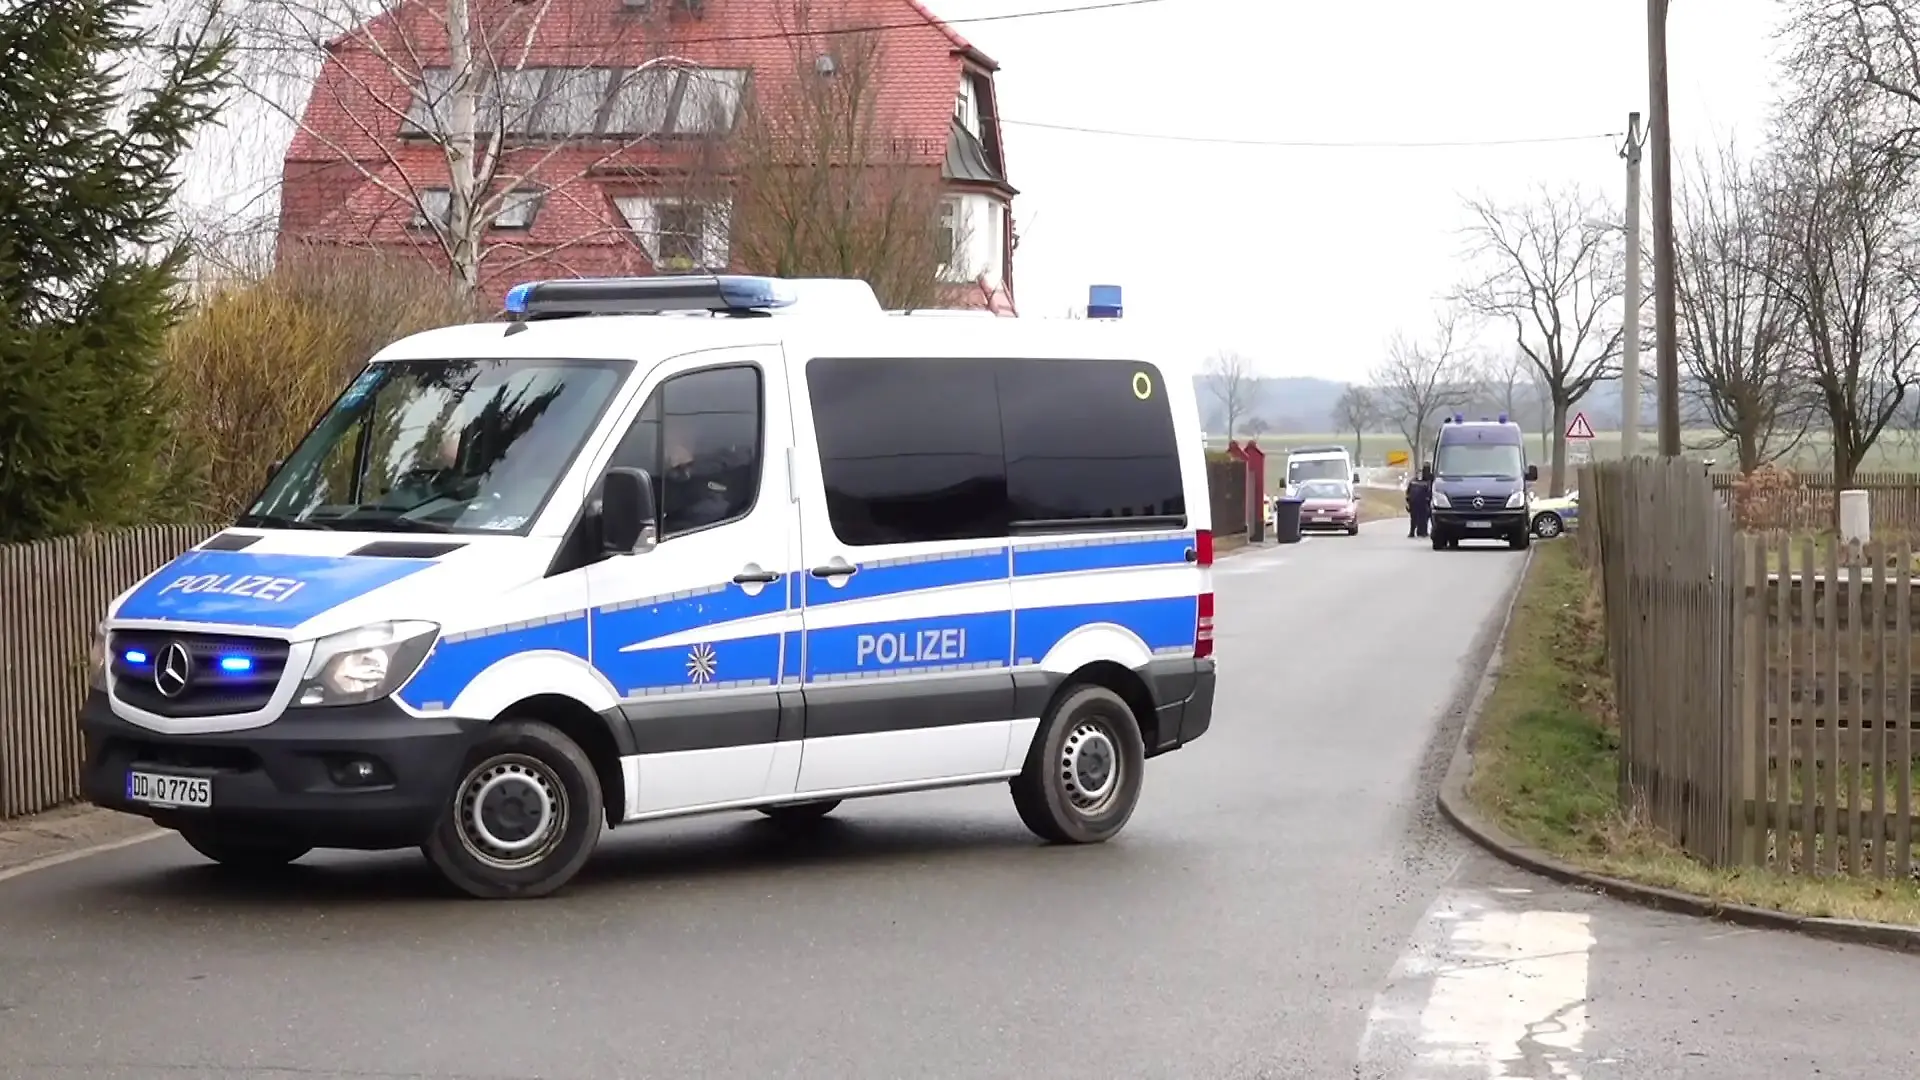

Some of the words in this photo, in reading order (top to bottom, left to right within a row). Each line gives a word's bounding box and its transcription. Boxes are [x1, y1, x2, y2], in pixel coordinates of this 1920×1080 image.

[157, 573, 307, 603] POLIZEI
[856, 627, 966, 666] POLIZEI
[134, 775, 149, 797] DD
[169, 779, 209, 803] 7765
